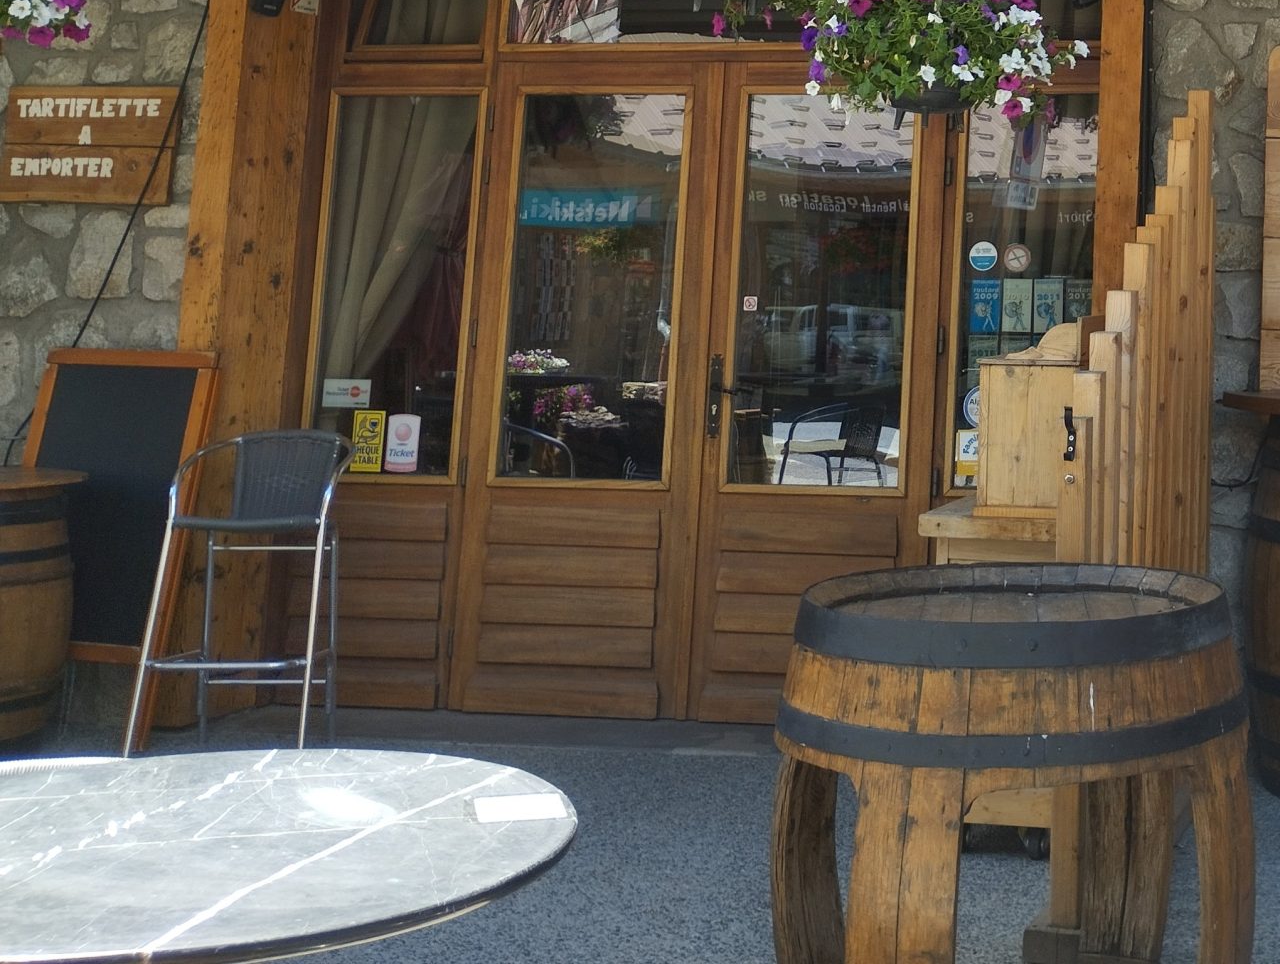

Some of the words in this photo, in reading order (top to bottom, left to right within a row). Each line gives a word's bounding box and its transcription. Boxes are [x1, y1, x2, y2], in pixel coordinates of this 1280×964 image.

[17, 97, 161, 118] TARTIFLETTE
[78, 125, 91, 145] A
[10, 157, 114, 178] EMPORTER
[974, 292, 999, 300] 2009
[1036, 292, 1061, 301] 2011
[389, 448, 415, 458] Ticket
[359, 456, 379, 465] TABLE
